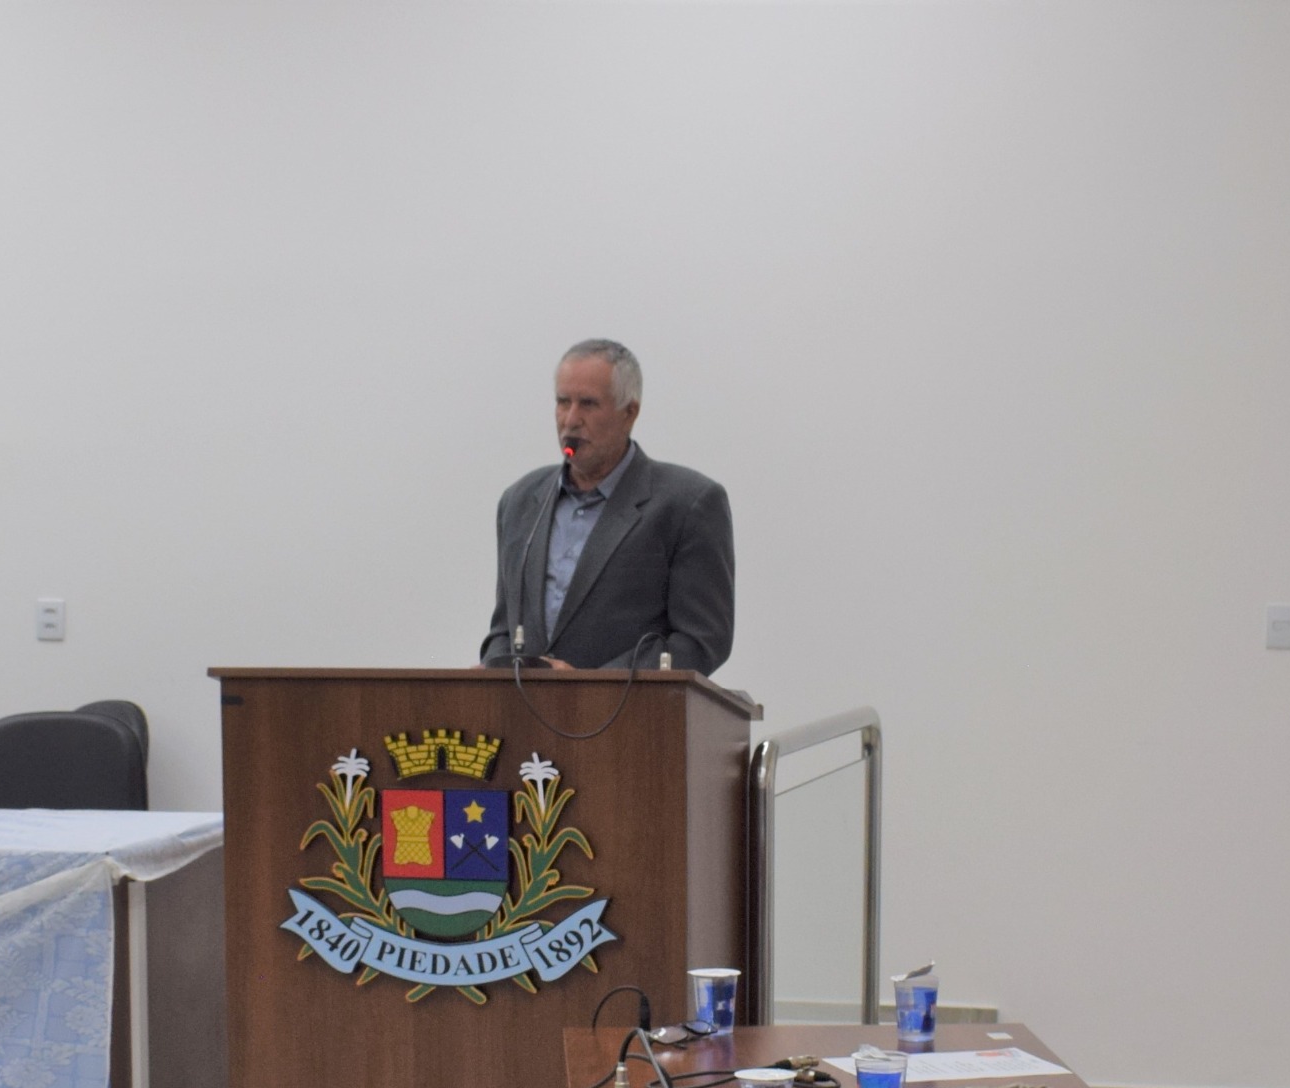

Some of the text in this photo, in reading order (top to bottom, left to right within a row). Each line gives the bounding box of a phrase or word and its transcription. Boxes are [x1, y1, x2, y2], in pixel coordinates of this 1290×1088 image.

[295, 908, 603, 977] 1840 PIEDADE 1892
